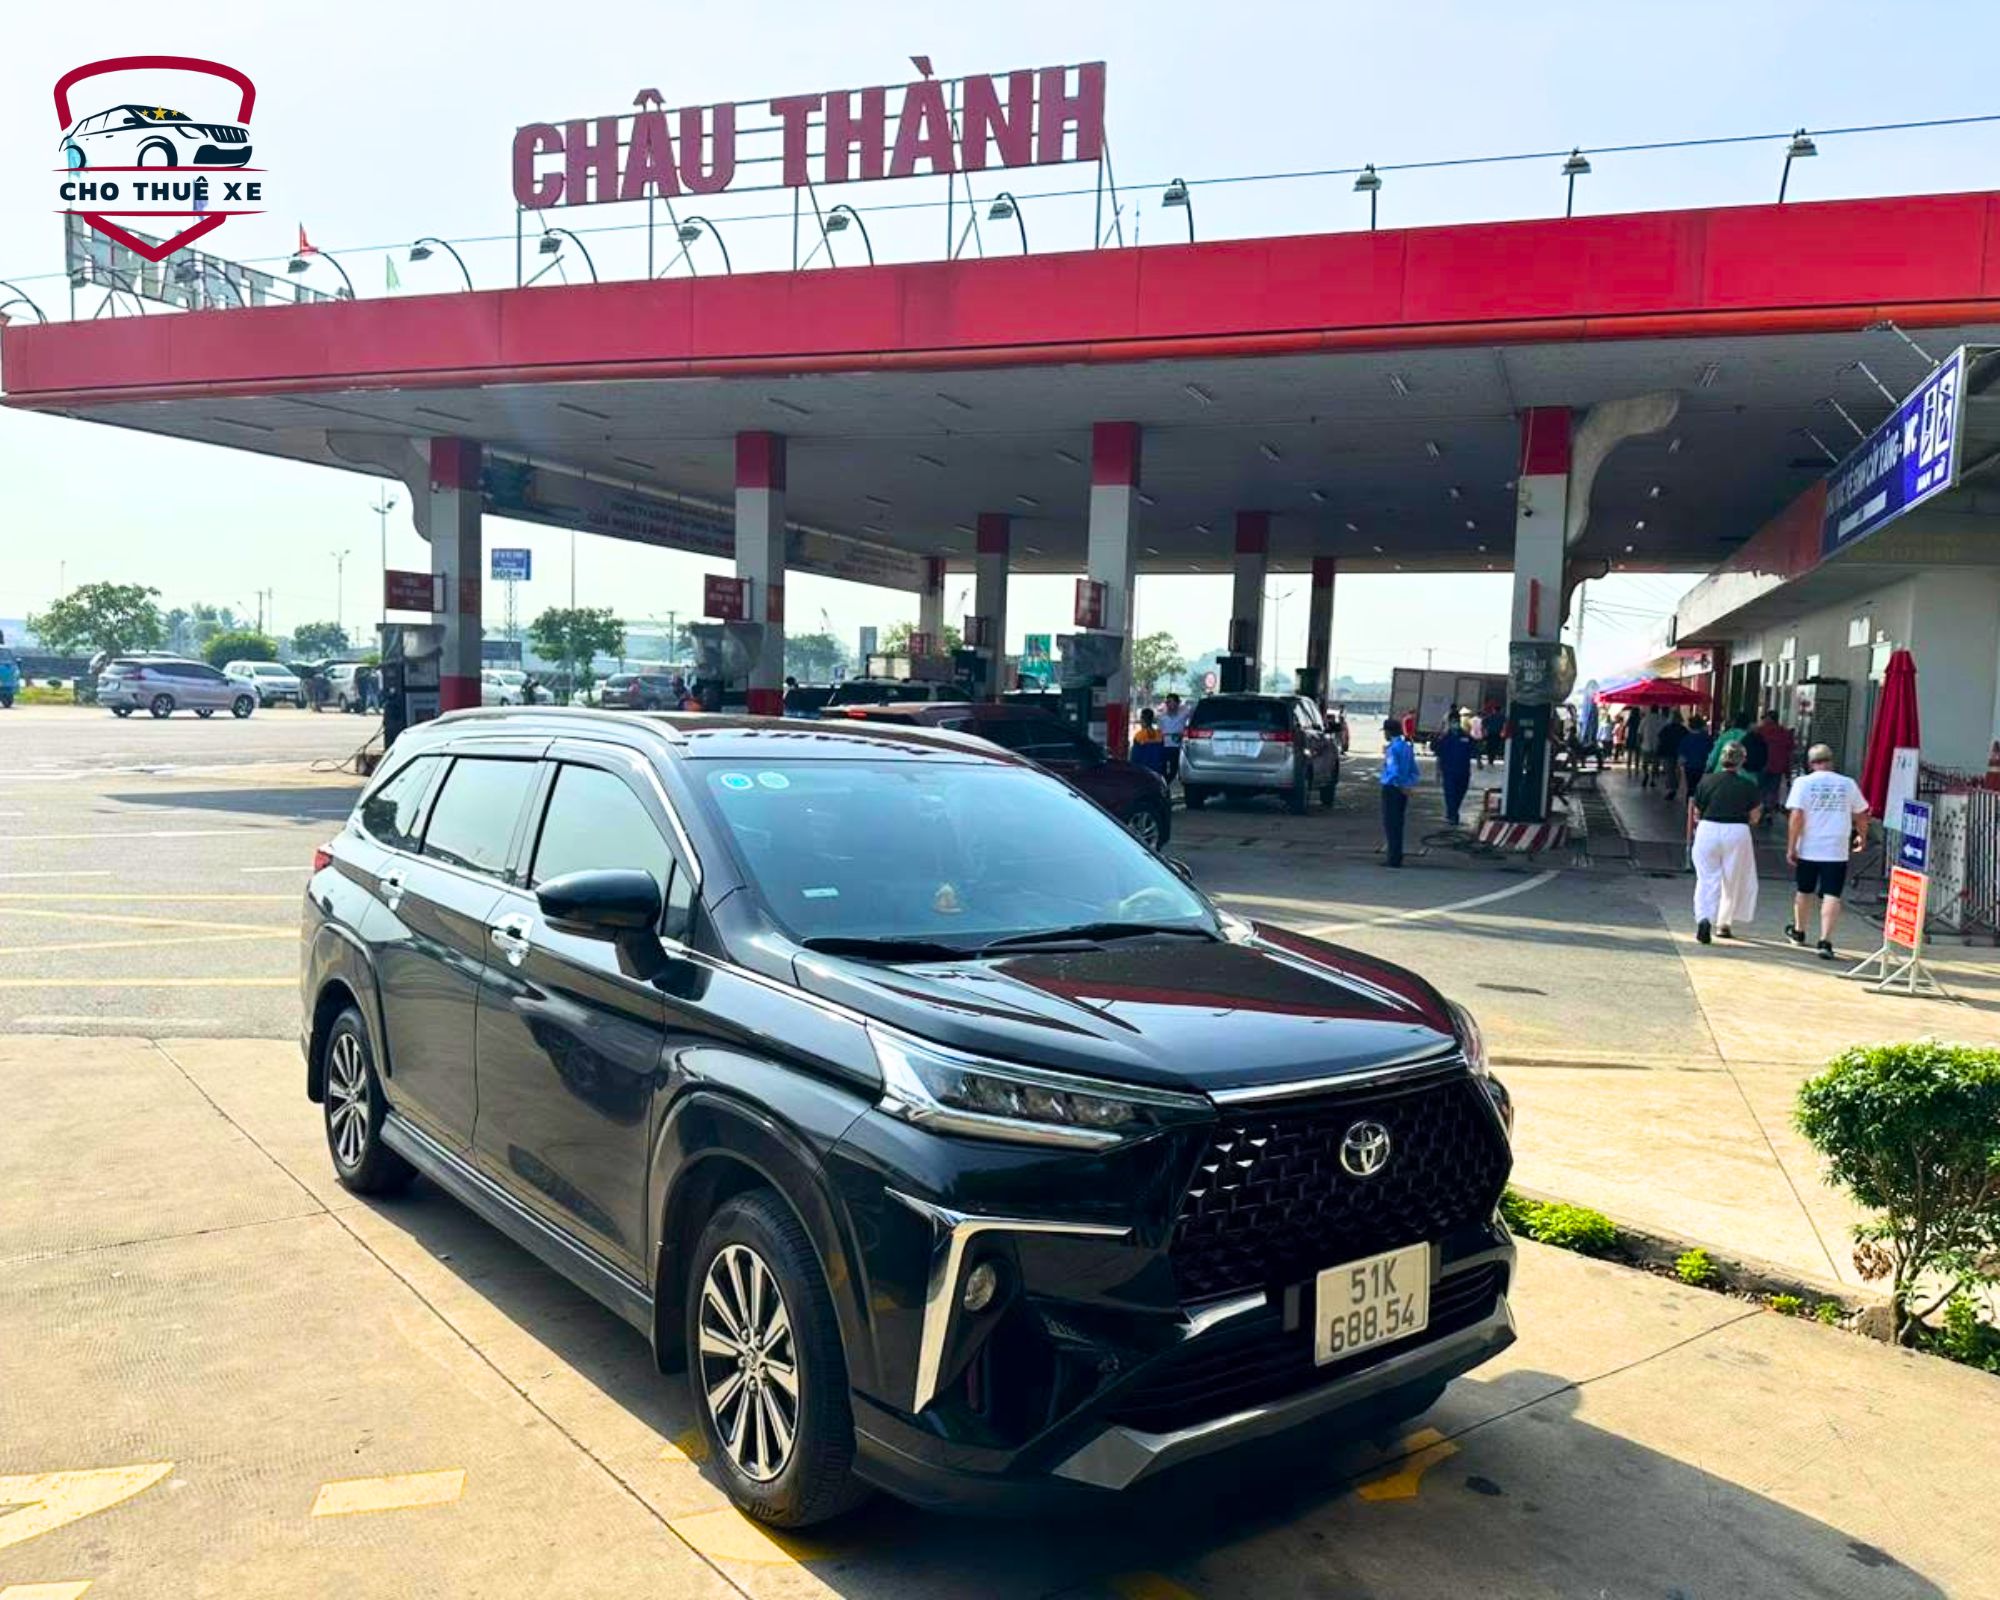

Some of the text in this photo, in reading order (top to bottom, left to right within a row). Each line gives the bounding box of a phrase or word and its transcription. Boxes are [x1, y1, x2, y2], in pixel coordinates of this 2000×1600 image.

[512, 56, 1106, 209] CHÂU THÀNH
[1351, 1258, 1398, 1305] 51K
[1331, 1293, 1414, 1352] 688.54
